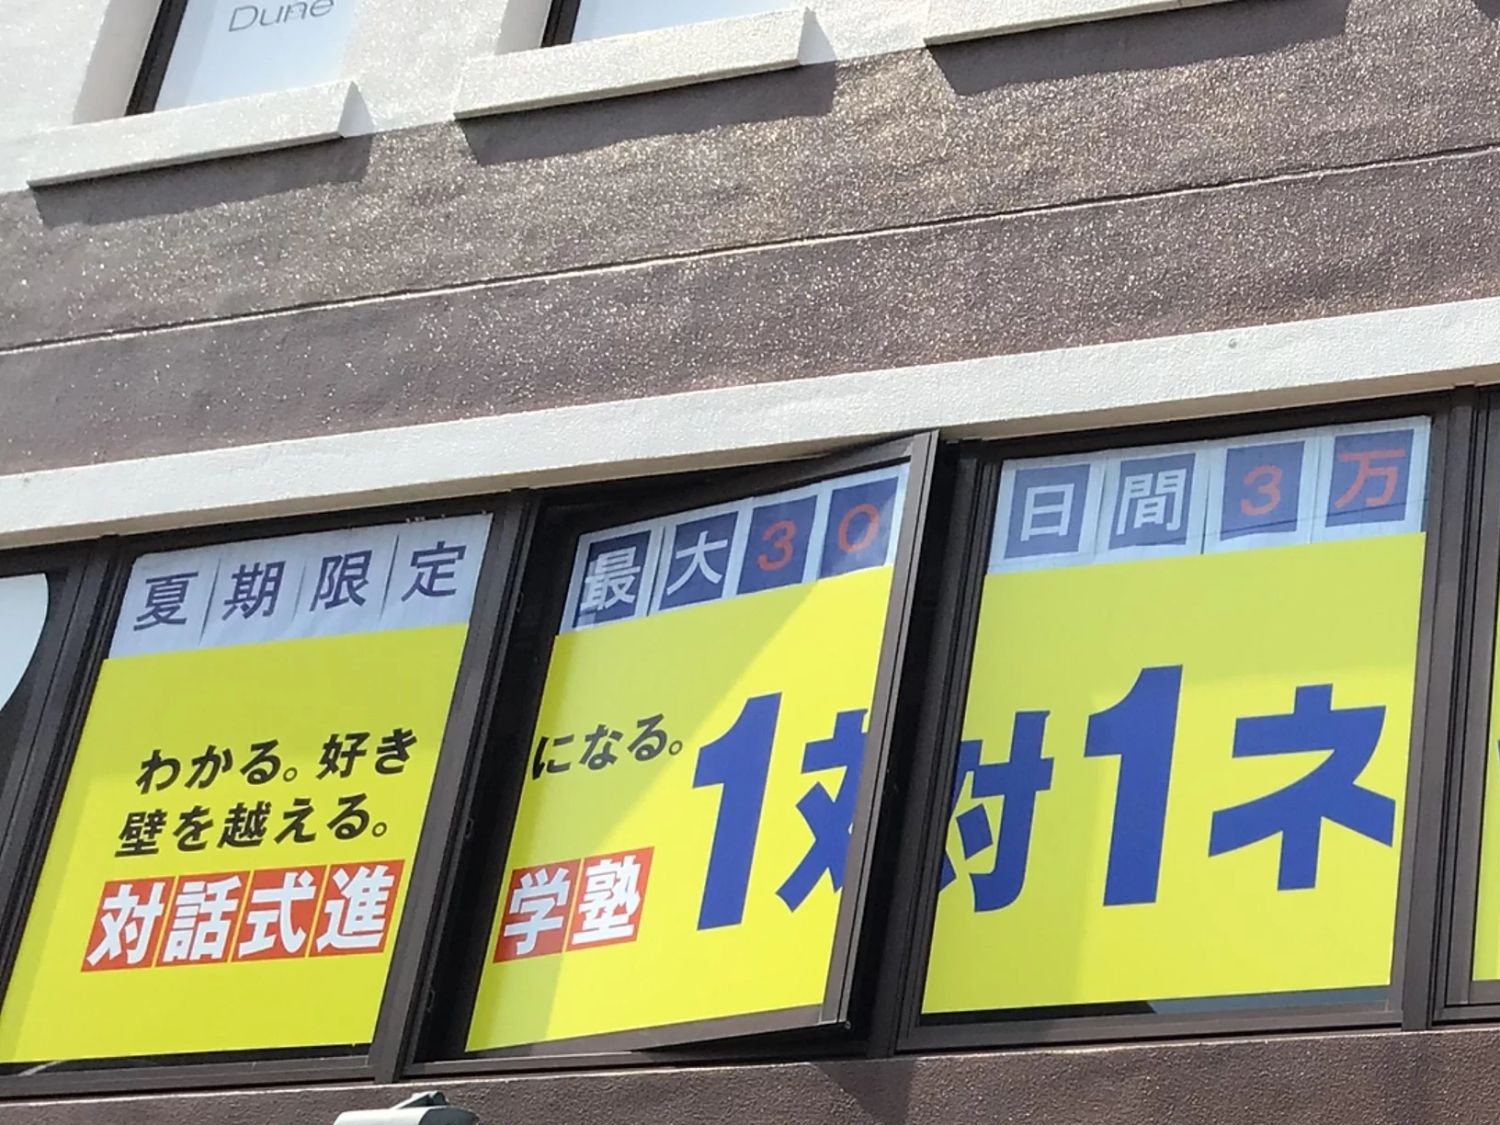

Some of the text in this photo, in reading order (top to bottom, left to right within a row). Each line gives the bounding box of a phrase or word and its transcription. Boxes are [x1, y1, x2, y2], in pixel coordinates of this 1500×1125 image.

[229, 0, 334, 32] Dune
[1019, 449, 1407, 542] 日間3万
[134, 541, 466, 631] 夏期限定
[579, 503, 882, 612] 最大30
[135, 728, 418, 794] わかる。好き
[531, 713, 684, 780] になる。
[114, 793, 389, 858] 壁を越える。
[86, 865, 398, 971] 対話式進
[502, 854, 643, 956] 学塾
